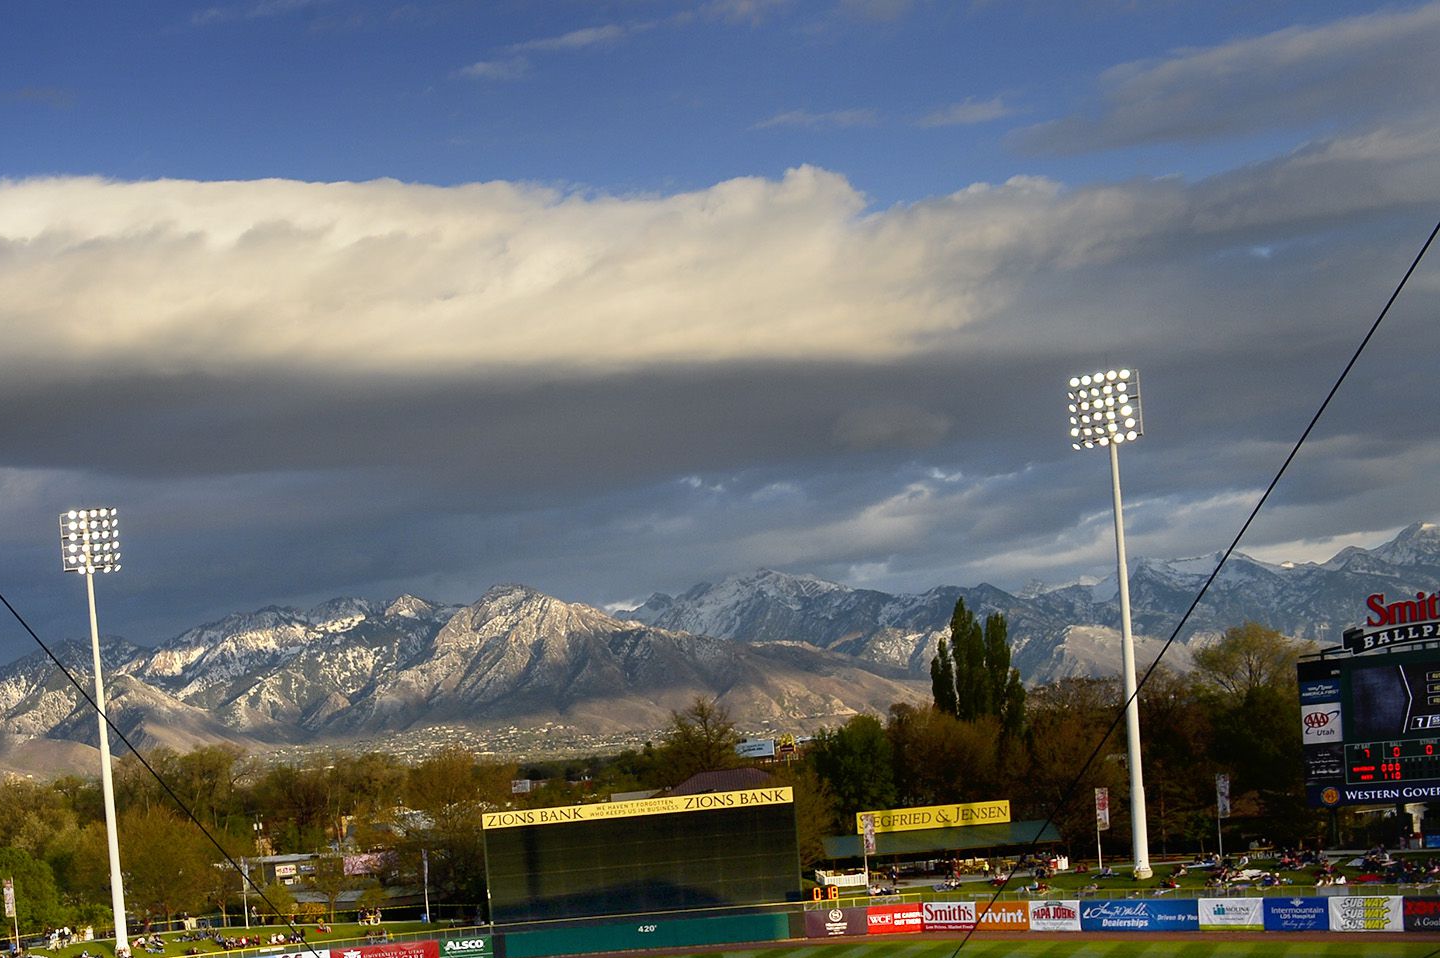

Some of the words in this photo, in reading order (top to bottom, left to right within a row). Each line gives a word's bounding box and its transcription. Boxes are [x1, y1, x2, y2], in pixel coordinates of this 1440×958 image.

[1367, 591, 1440, 627] Smit
[1305, 714, 1328, 727] AAA
[1317, 728, 1335, 736] Utah
[1393, 747, 1400, 757] 0
[1425, 745, 1433, 755] 0
[684, 794, 734, 809] ZIONS
[740, 790, 786, 804] BANK
[1345, 789, 1399, 800] WESTERN
[487, 812, 535, 827] ZIONS
[540, 808, 584, 822] BANK
[936, 809, 951, 823] &
[954, 806, 1008, 823] JENSEN
[1341, 897, 1389, 908] SUBWAY
[925, 904, 973, 921] Smith's
[1033, 907, 1050, 919] PAPA
[1341, 908, 1390, 918] SUBWAY
[869, 915, 892, 924] WCF
[1102, 918, 1148, 927] Dealerships
[1341, 919, 1390, 930] SUBWAY
[444, 940, 484, 950] ALSCO
[364, 951, 398, 958] UNIVERSITY
